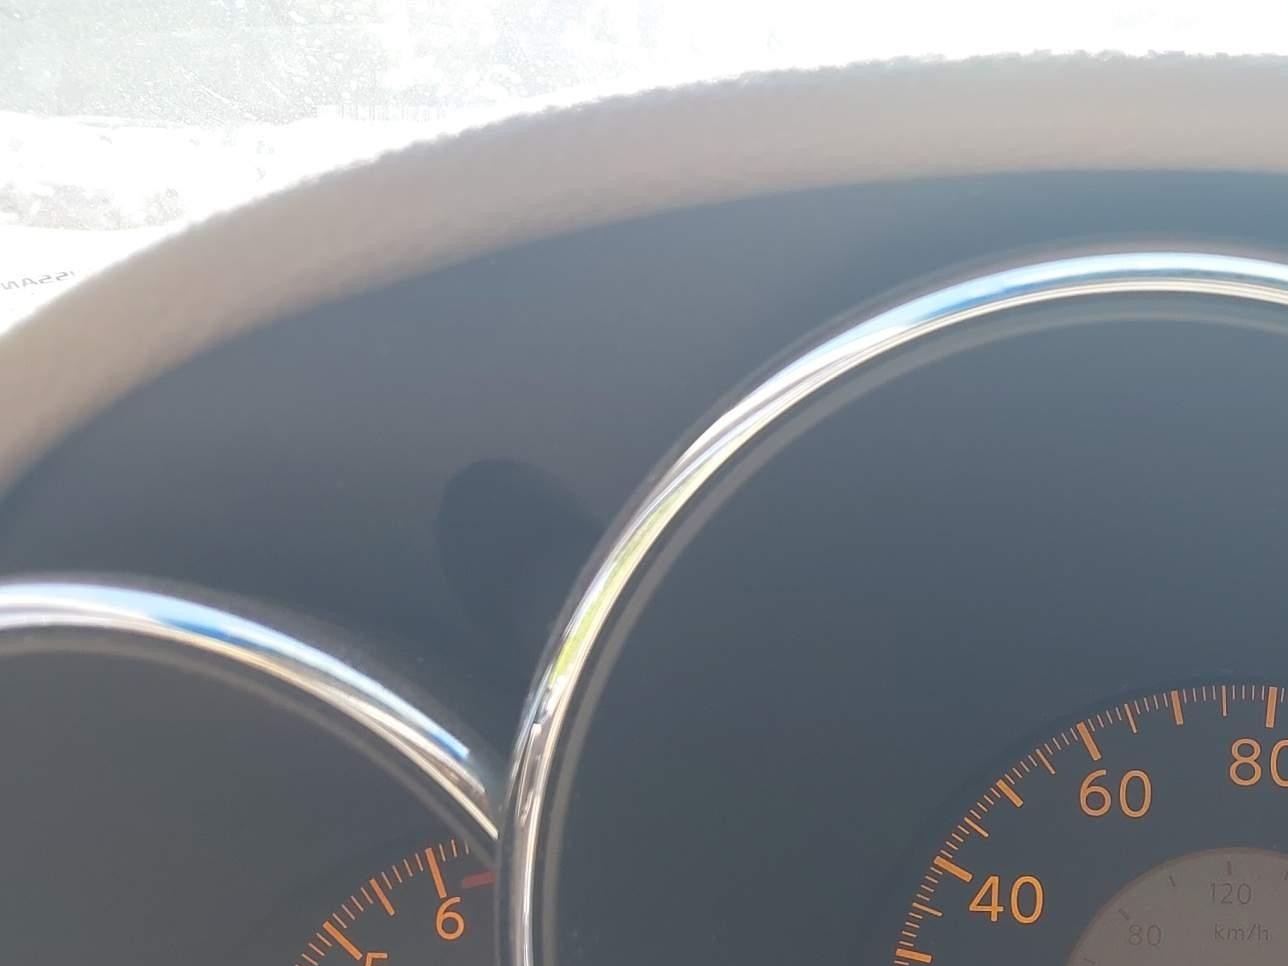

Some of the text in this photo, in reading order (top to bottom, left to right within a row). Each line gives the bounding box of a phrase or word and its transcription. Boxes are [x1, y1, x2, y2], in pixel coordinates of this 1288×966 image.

[1078, 769, 1154, 819] 60
[968, 875, 1045, 924] 40
[1209, 882, 1253, 905] 120
[435, 896, 464, 940] 6
[1213, 922, 1272, 942] km/h
[1128, 924, 1163, 947] 80
